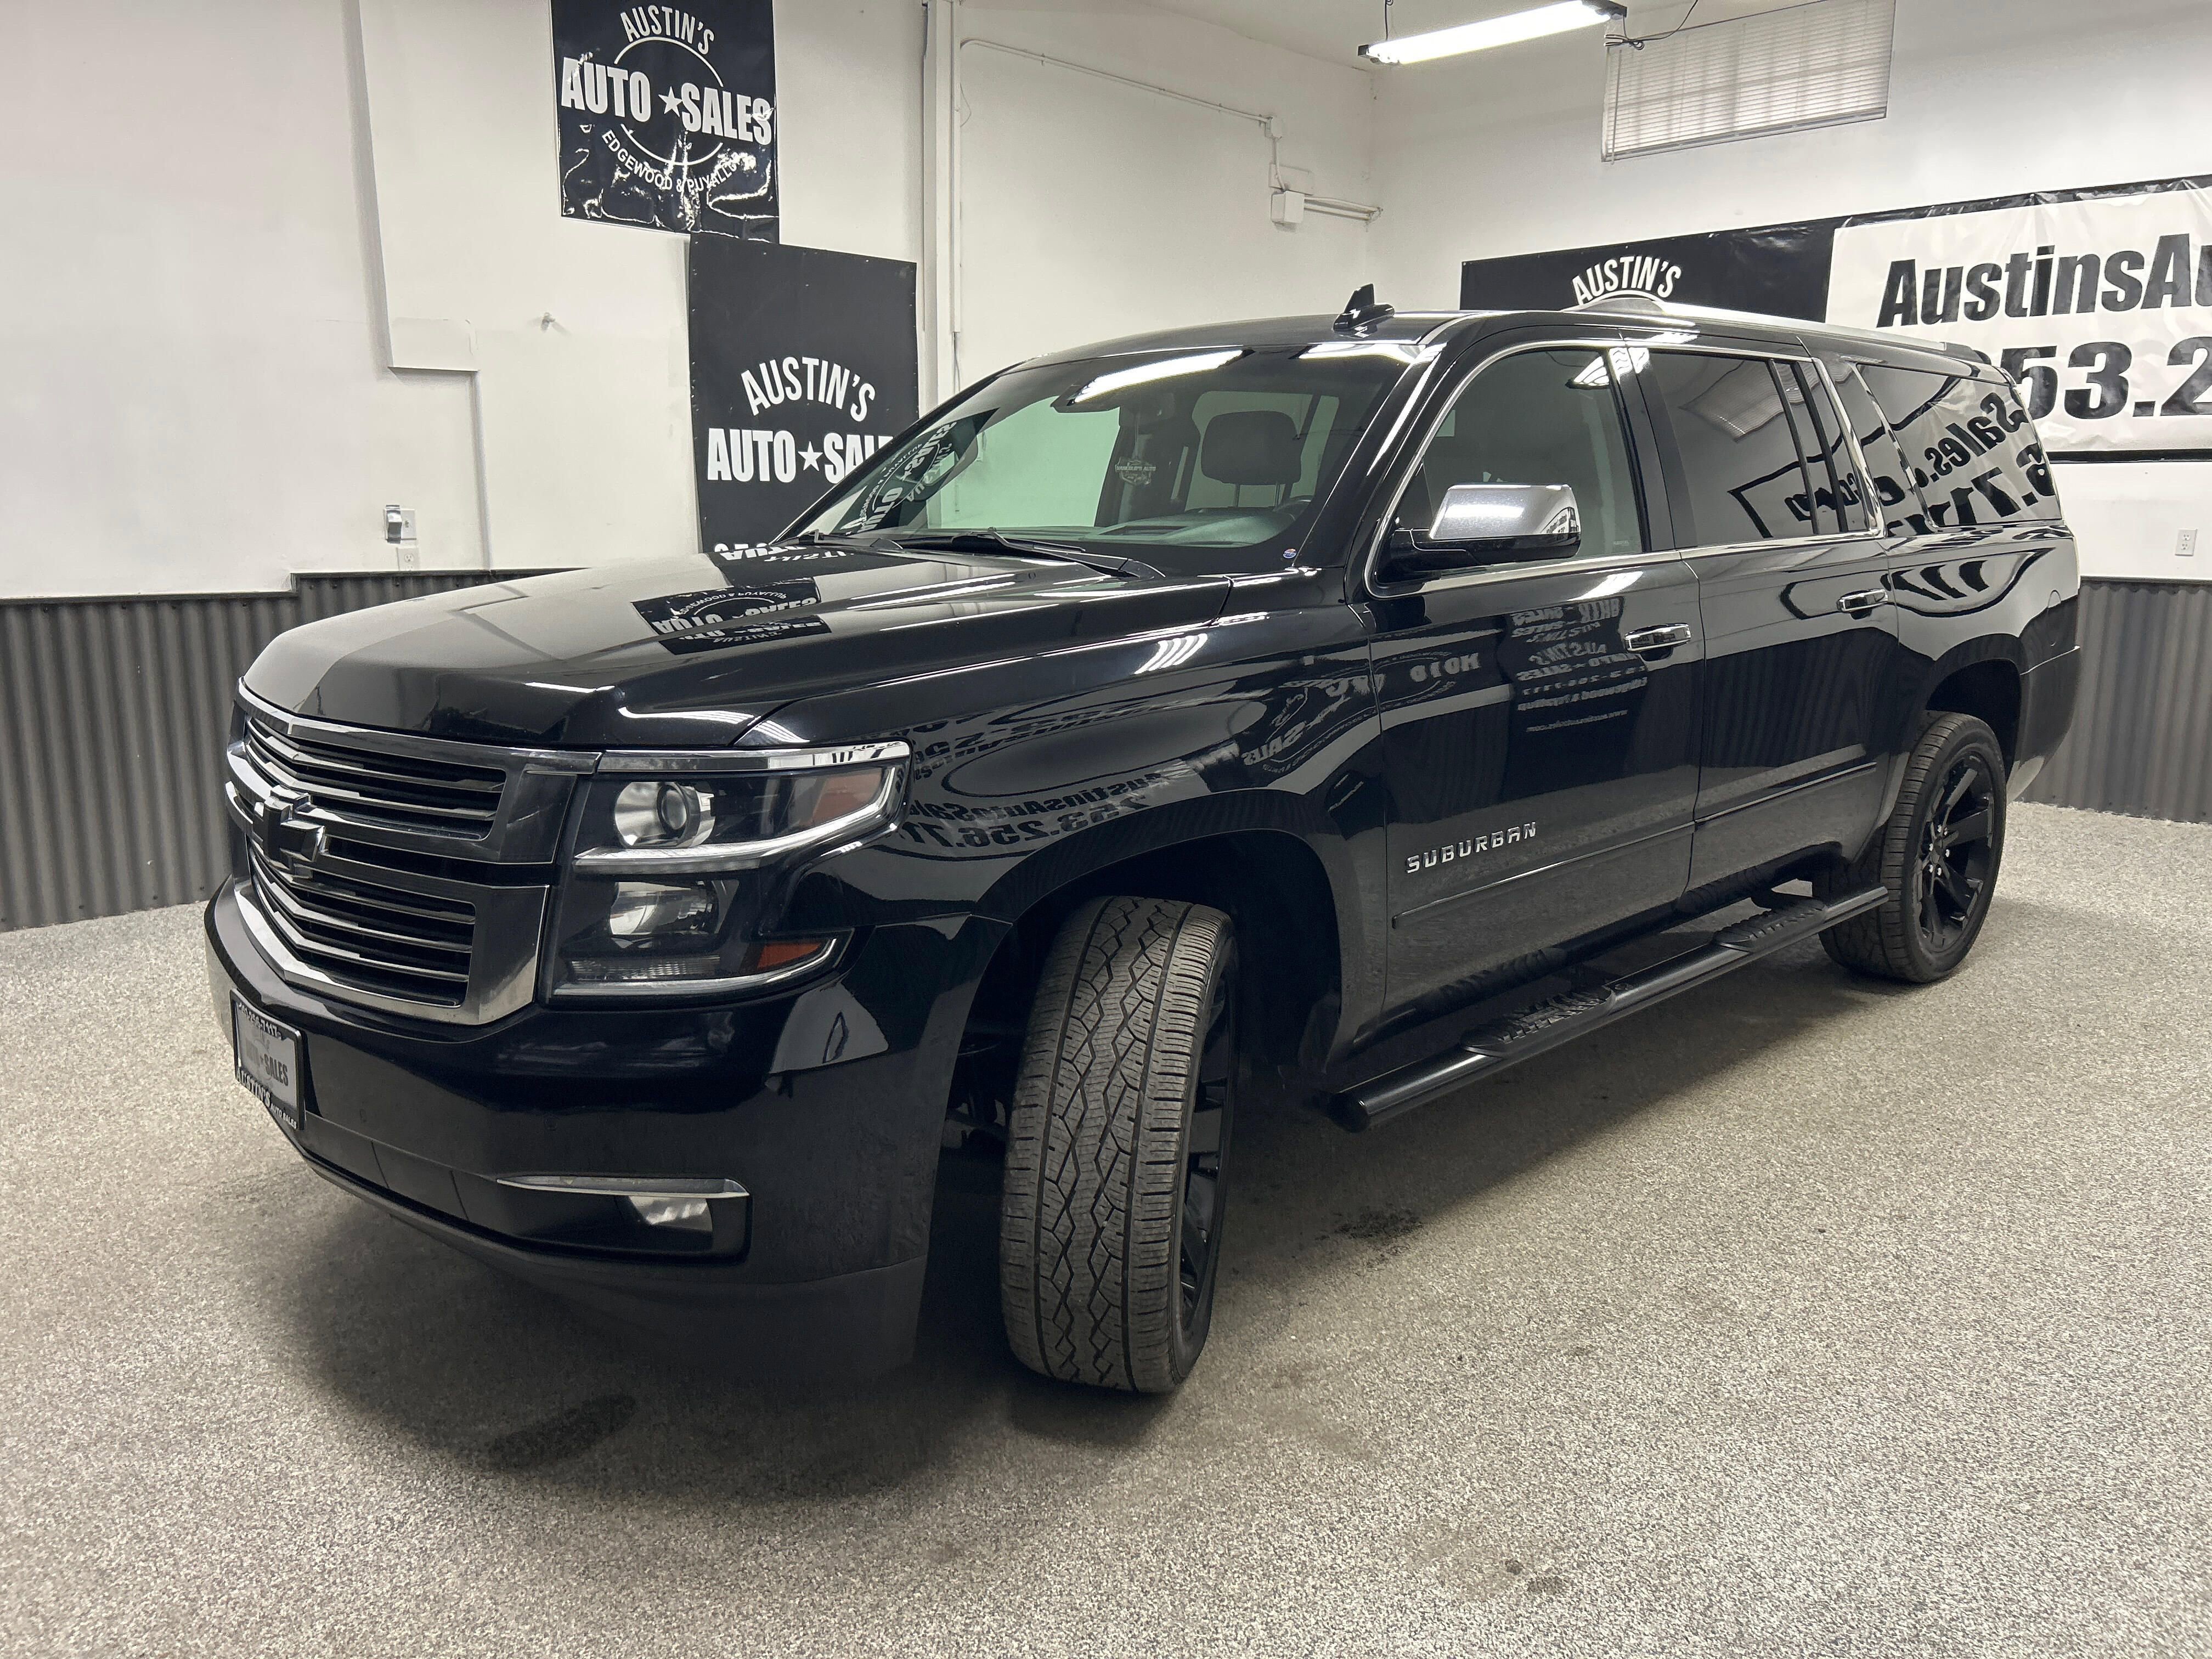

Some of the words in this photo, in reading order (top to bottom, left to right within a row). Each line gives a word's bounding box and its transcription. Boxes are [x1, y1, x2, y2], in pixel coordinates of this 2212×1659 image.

[620, 5, 714, 54] AUSTIN'S
[561, 57, 651, 122] AUTO
[681, 83, 772, 145] SALES
[602, 129, 673, 190] EDGEWOOD
[676, 178, 684, 192] &
[1572, 256, 1681, 306] AUSTIN'S
[741, 357, 876, 422] AUSTIN'S
[1975, 337, 2212, 420] 53.2
[707, 427, 796, 483] AUTO
[1406, 822, 1536, 873] SUBURBAN
[237, 1066, 270, 1107] AUSTIN'S
[270, 1103, 283, 1118] AUTO
[283, 1111, 297, 1130] SALES
[264, 1053, 289, 1086] SALES
